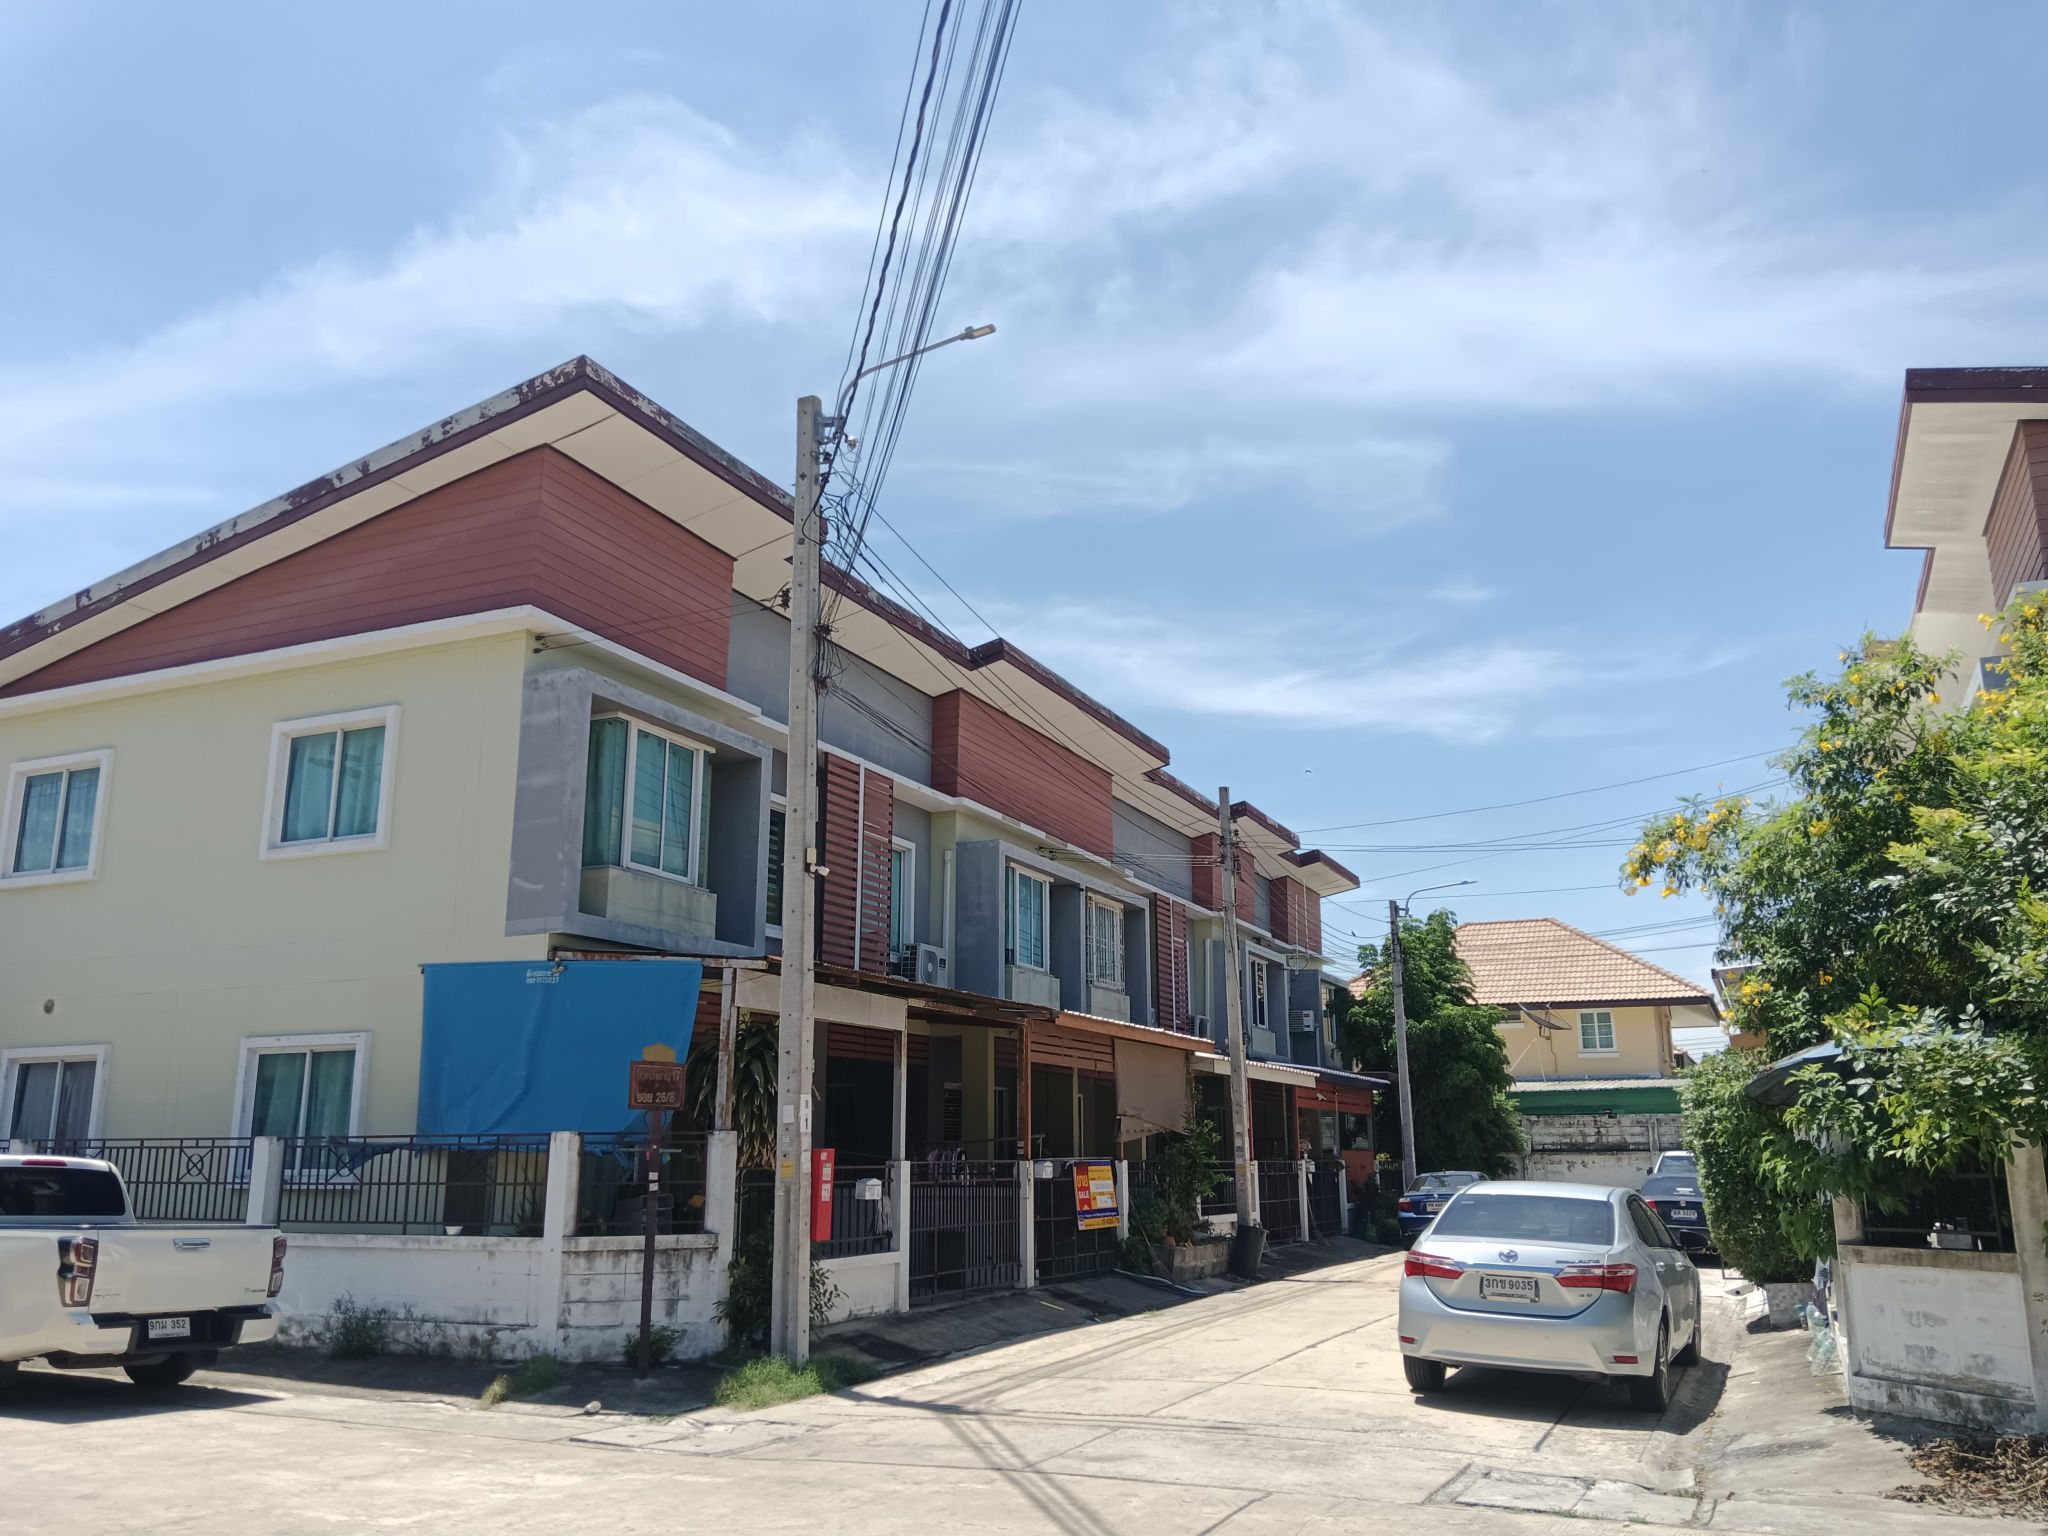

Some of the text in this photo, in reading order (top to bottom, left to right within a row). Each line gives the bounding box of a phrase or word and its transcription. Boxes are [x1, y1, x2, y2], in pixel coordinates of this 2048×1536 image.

[1078, 1190, 1090, 1199] SALE
[1508, 1279, 1534, 1291] 9035
[171, 1319, 186, 1329] 352
